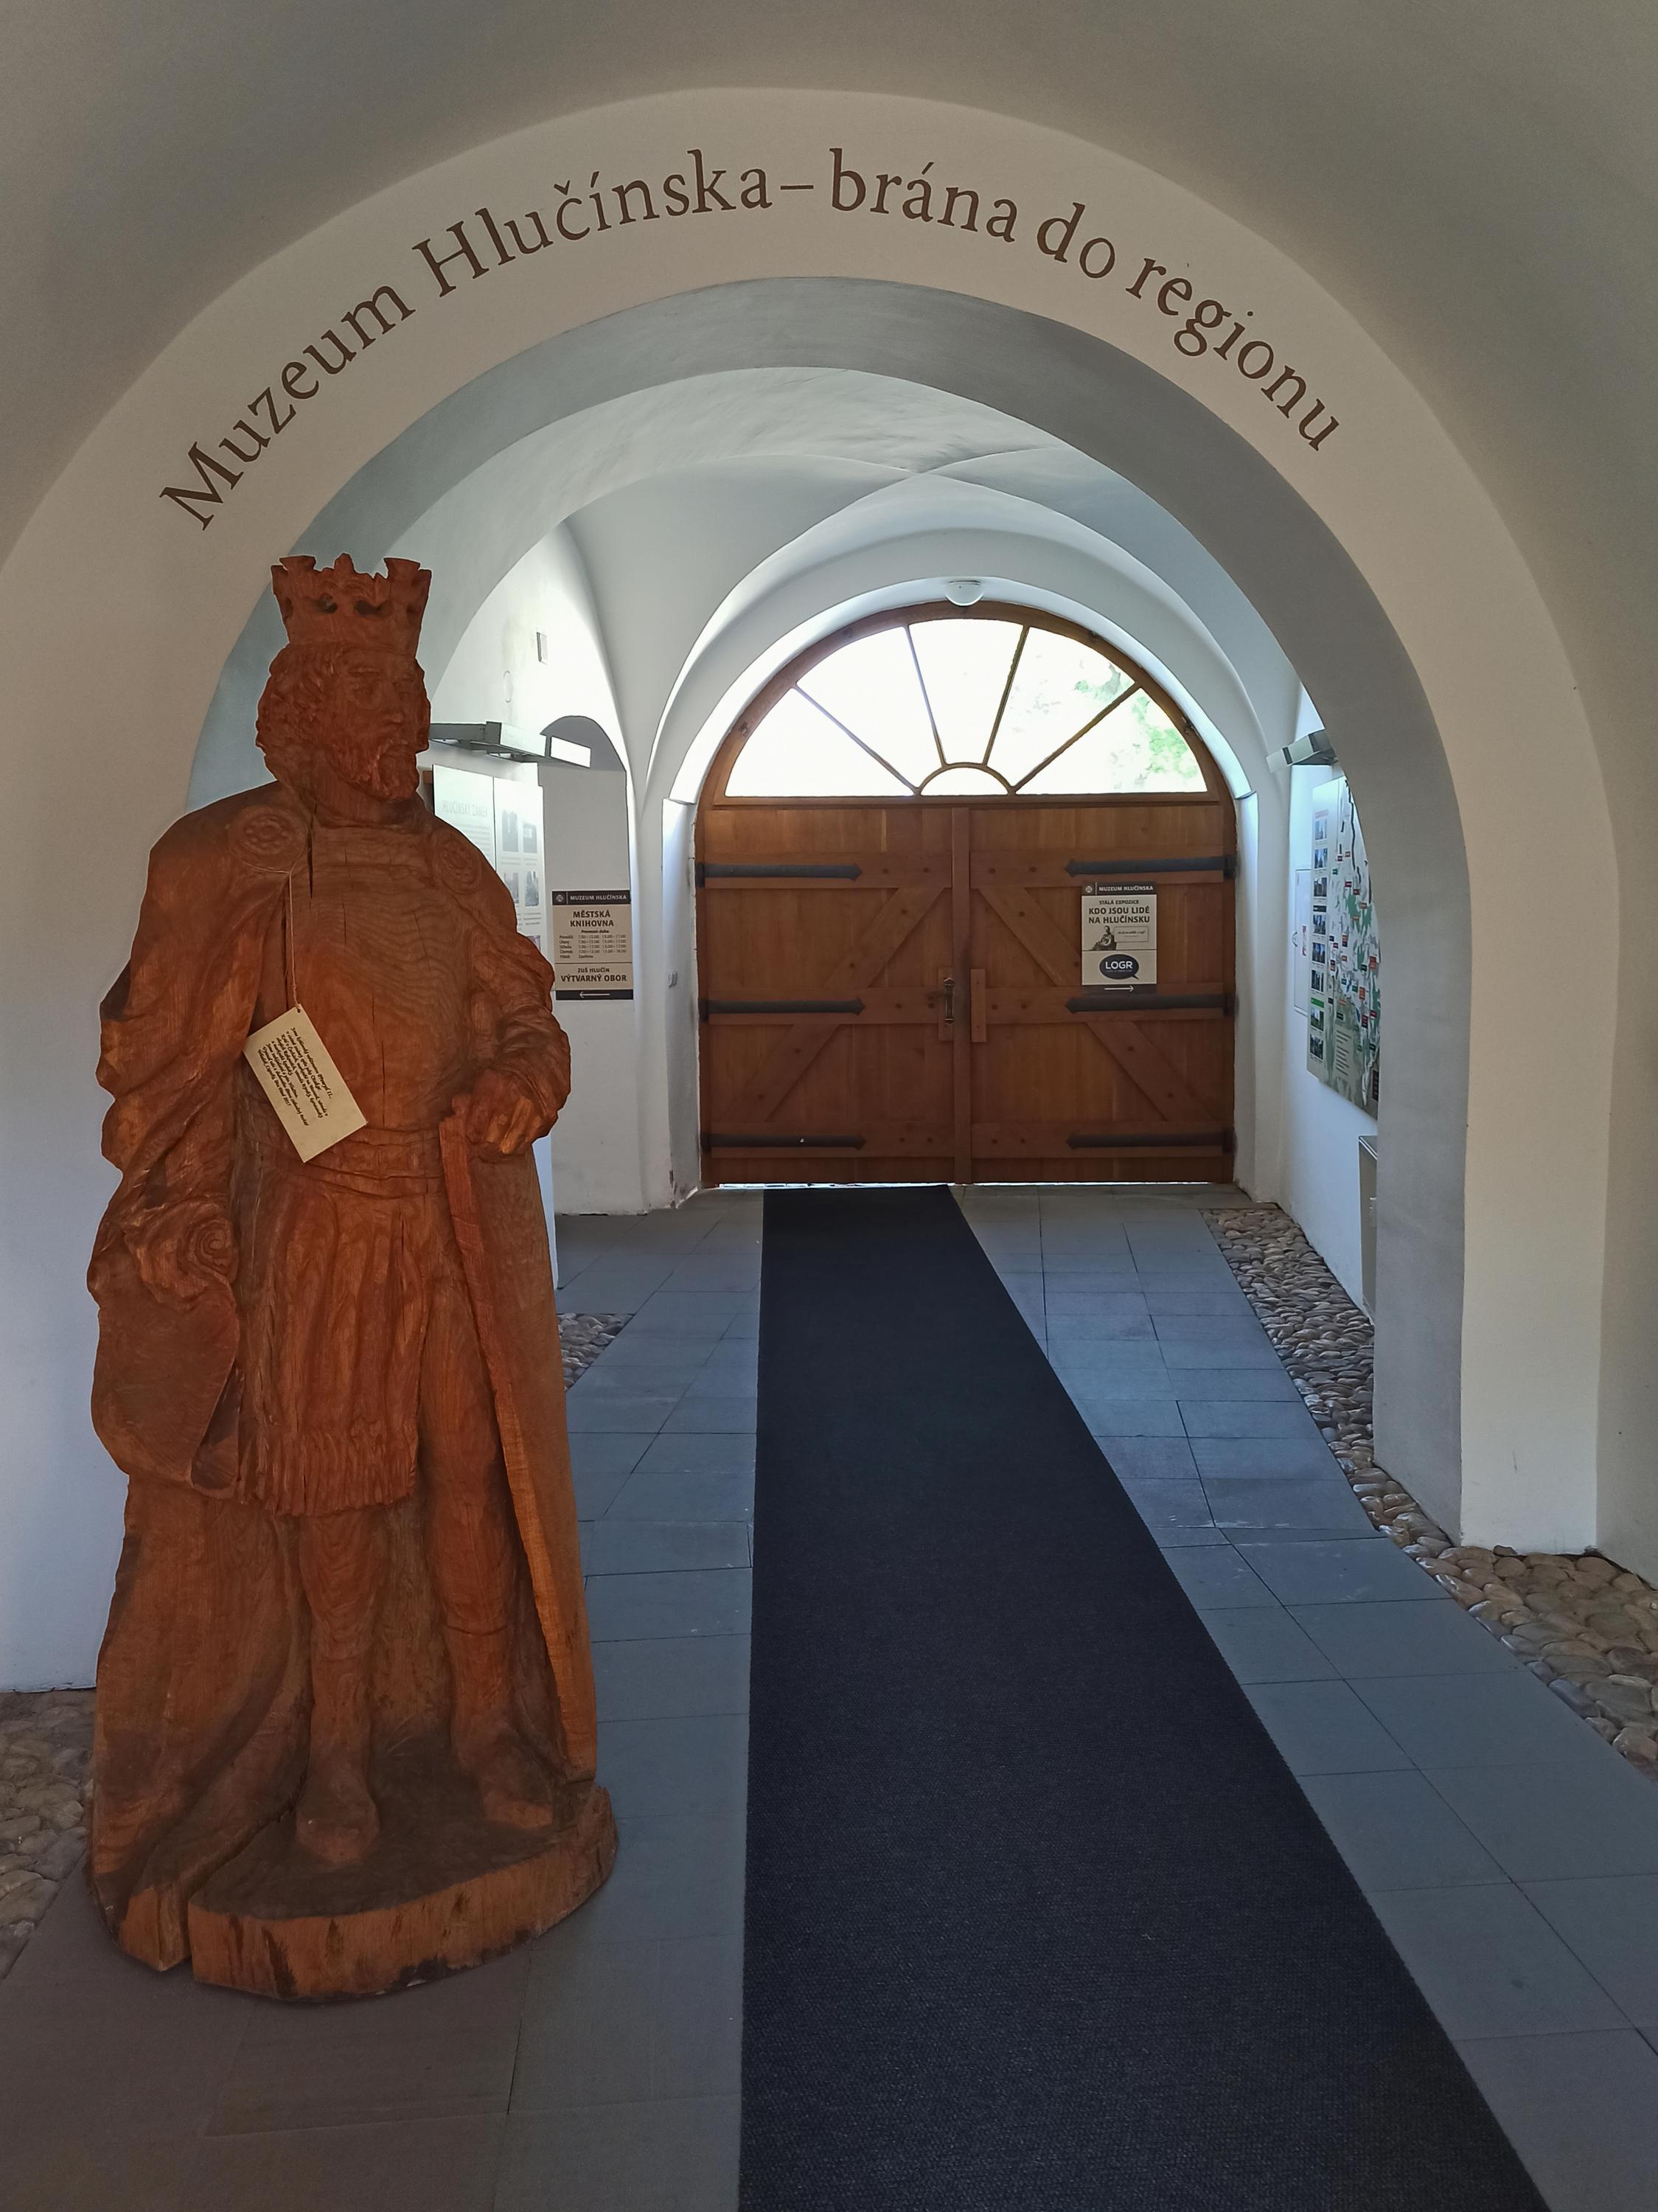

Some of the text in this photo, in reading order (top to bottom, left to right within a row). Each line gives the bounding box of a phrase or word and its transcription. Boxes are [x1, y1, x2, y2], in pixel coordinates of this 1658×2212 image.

[159, 286, 417, 532] Muzeum
[412, 149, 773, 299] Hlučínska
[829, 148, 1018, 244] brána
[1037, 203, 1116, 279] do
[1126, 258, 1340, 453] regionu
[573, 909, 610, 918] MĚSTSKÁ
[1132, 905, 1149, 914] LIDÉ
[1103, 915, 1149, 923] HLUČÍNSKU
[1105, 961, 1133, 969] LOGR
[561, 973, 602, 982] VÝTVARNÝ
